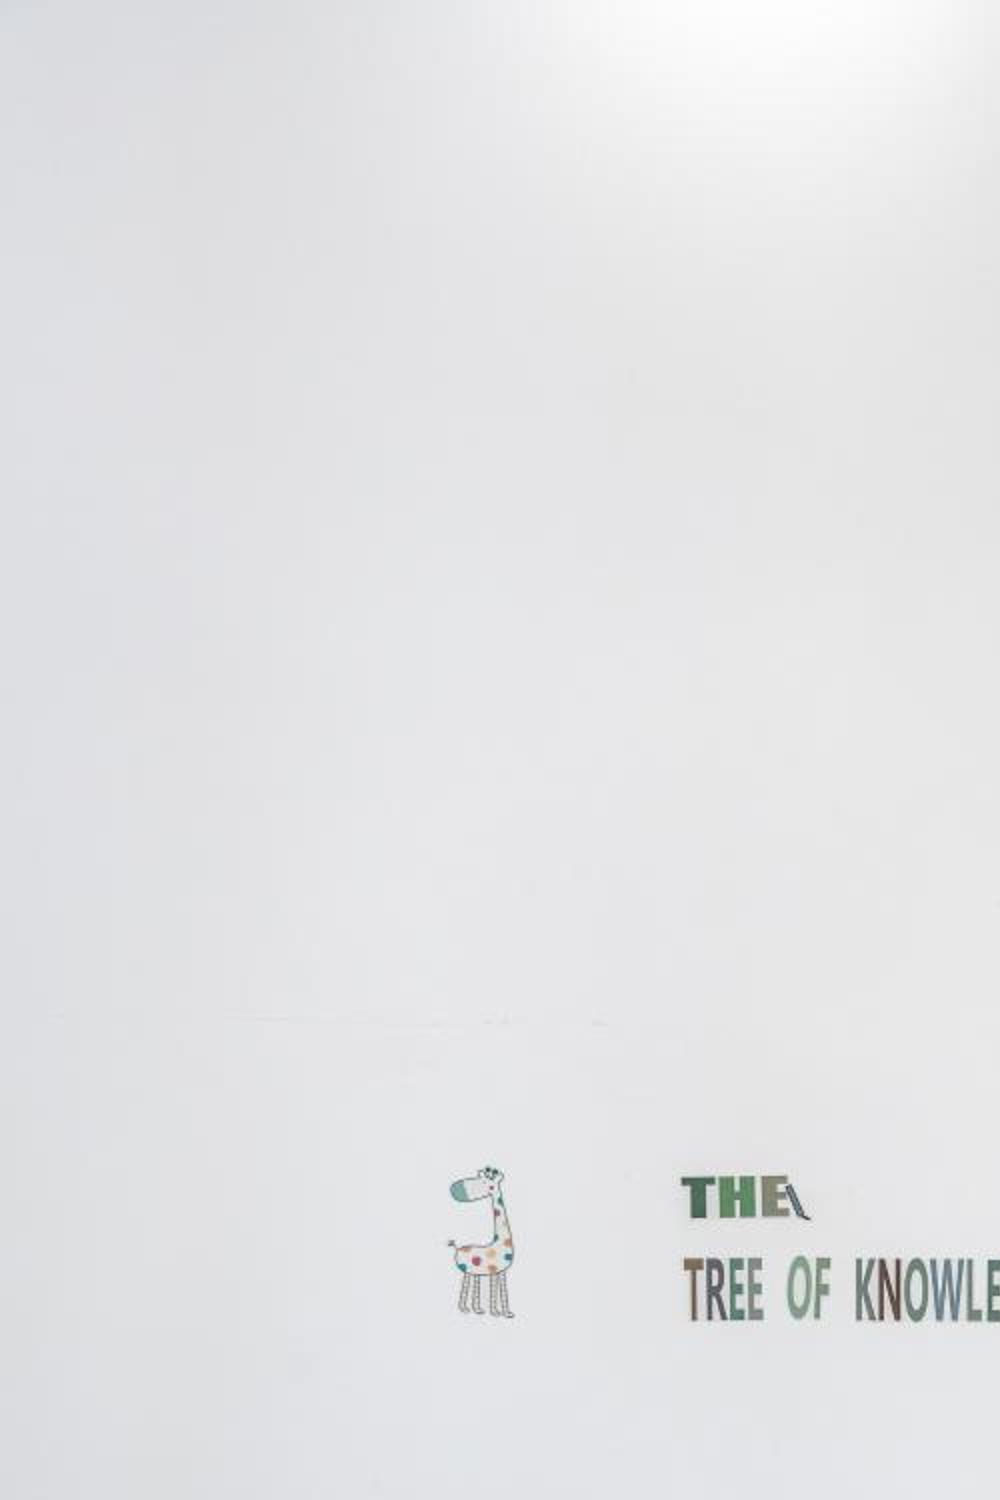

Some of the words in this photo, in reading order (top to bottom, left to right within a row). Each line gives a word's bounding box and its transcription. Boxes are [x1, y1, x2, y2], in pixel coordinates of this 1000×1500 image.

[681, 1175, 790, 1219] THE
[683, 1257, 764, 1321] TREE
[786, 1255, 831, 1320] OF
